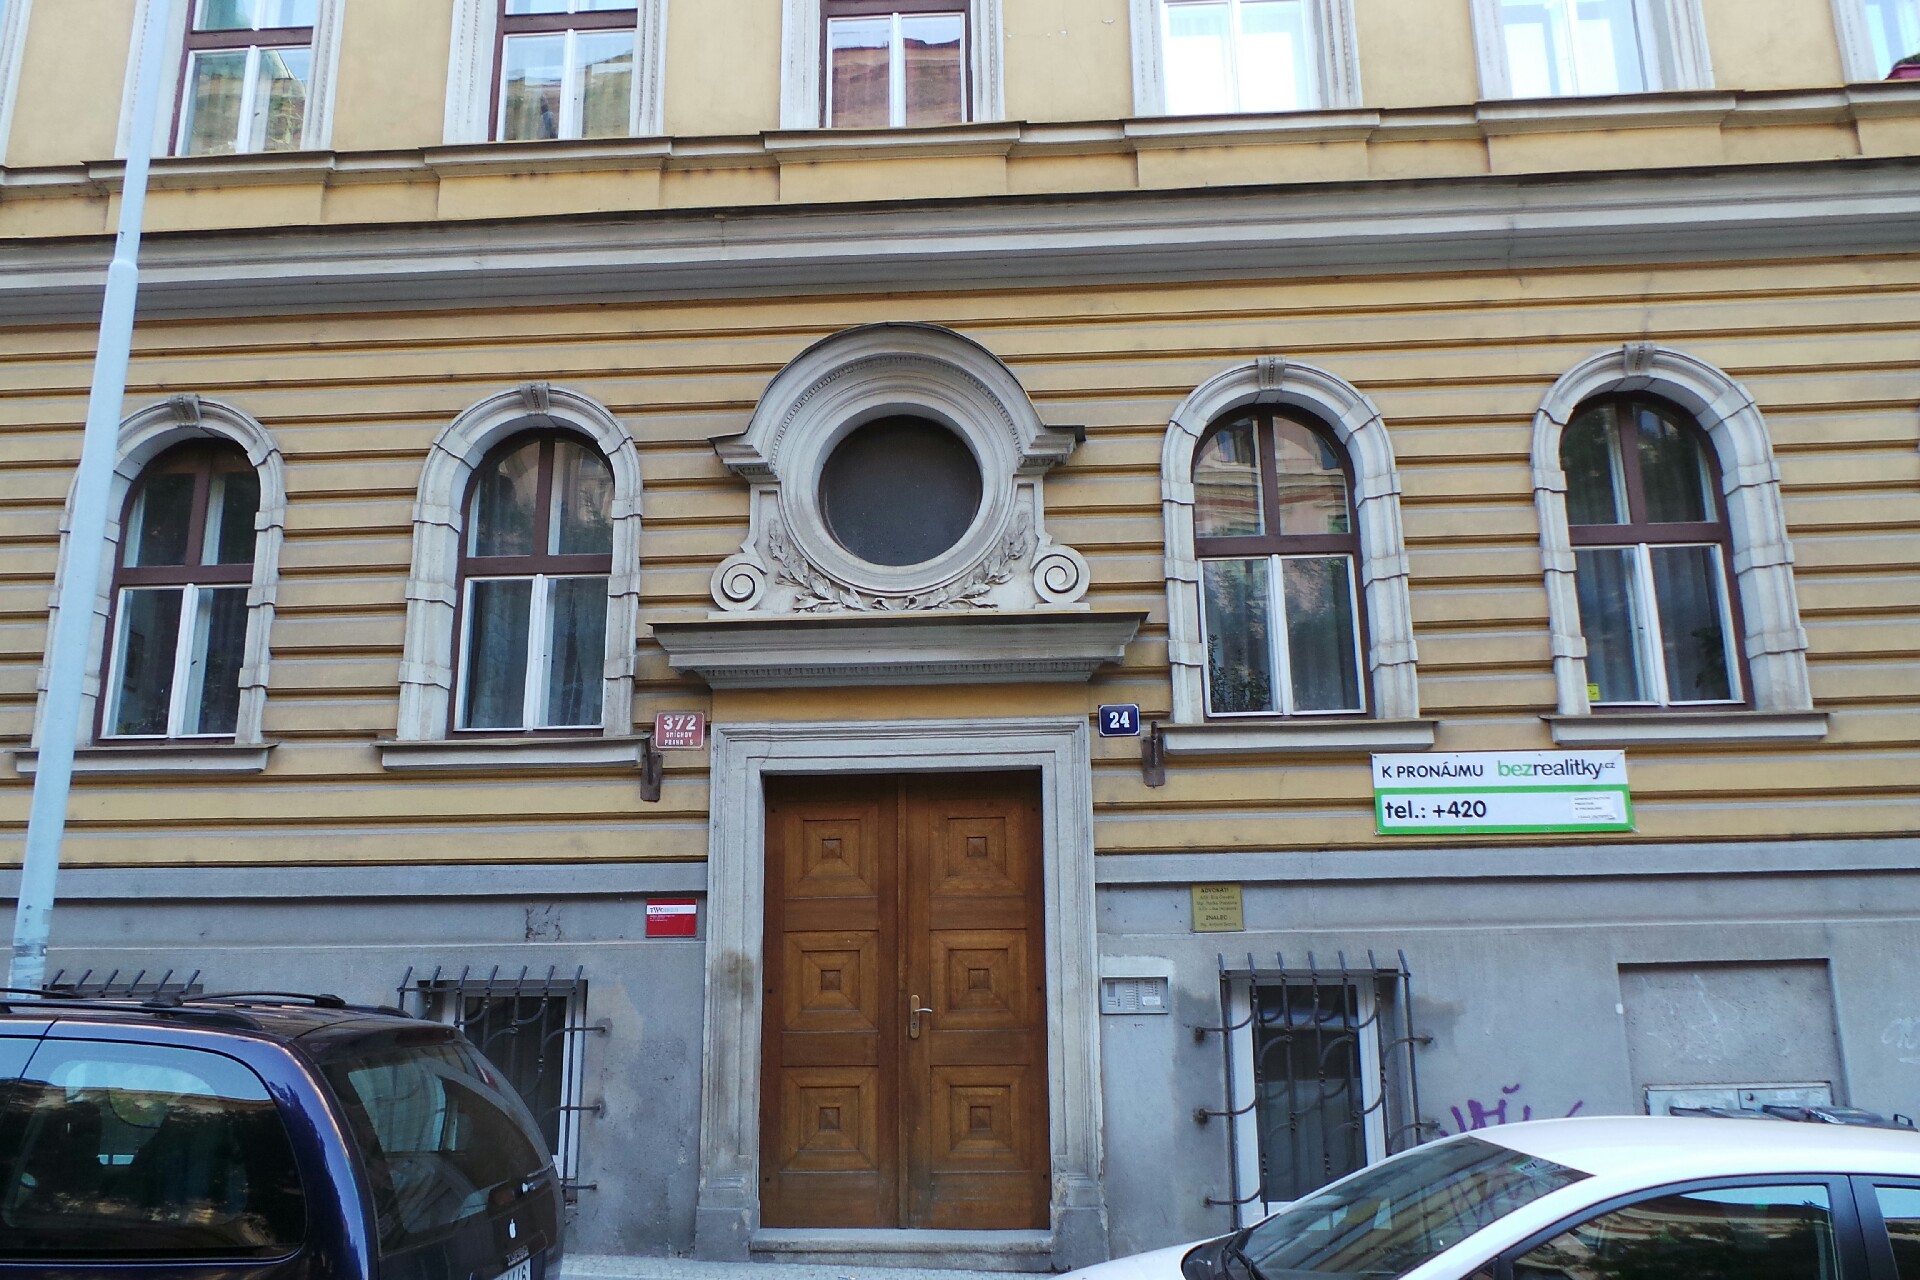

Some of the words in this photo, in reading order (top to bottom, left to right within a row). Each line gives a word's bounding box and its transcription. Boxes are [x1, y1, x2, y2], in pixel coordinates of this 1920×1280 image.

[663, 715, 696, 730] 372
[1110, 711, 1130, 728] 24
[1382, 765, 1392, 778] K
[1397, 761, 1483, 778] PRONÁJMU
[1497, 758, 1615, 780] bezrealitky.cz
[1385, 800, 1426, 819] tel.:
[1433, 800, 1487, 818] +420
